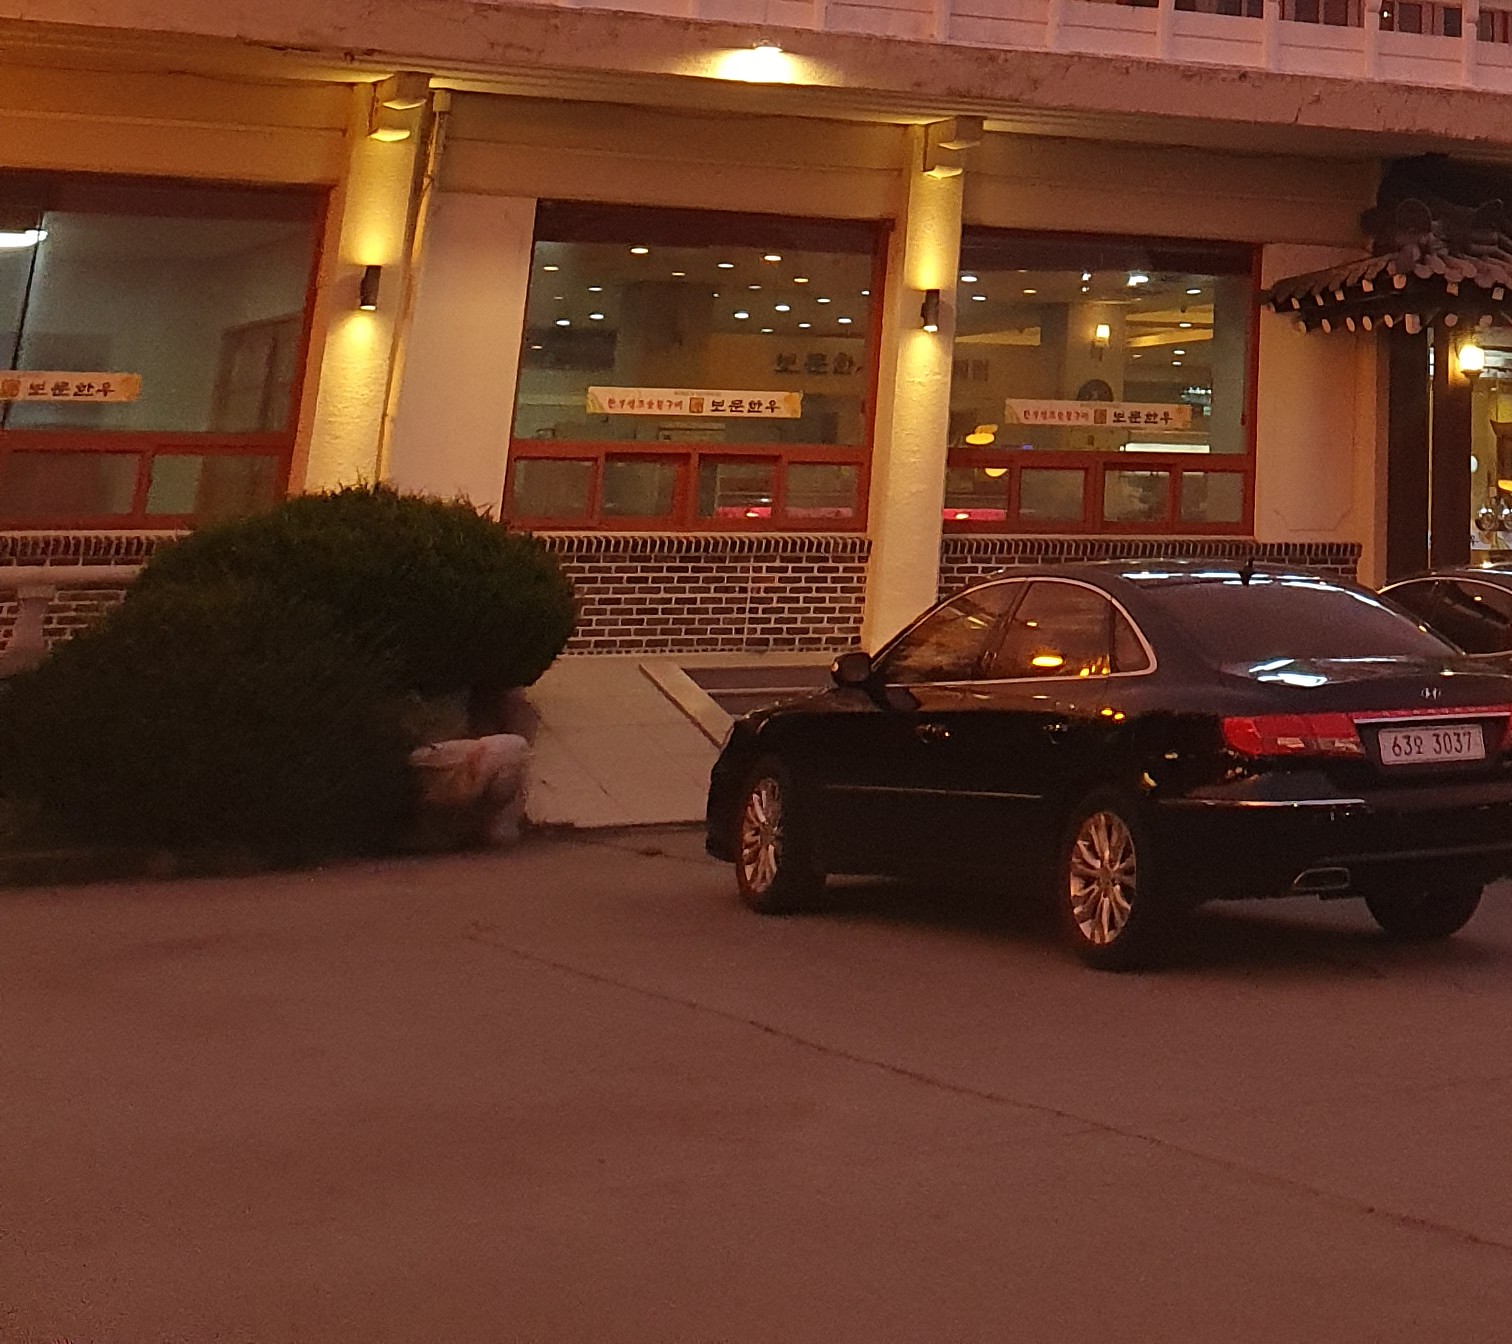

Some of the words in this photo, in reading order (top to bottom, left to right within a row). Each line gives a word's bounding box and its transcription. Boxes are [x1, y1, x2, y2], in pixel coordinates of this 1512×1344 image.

[28, 381, 115, 397] 보문한우
[711, 399, 781, 413] 보문한우
[1113, 410, 1173, 425] 보문한우
[1432, 732, 1472, 754] 3037
